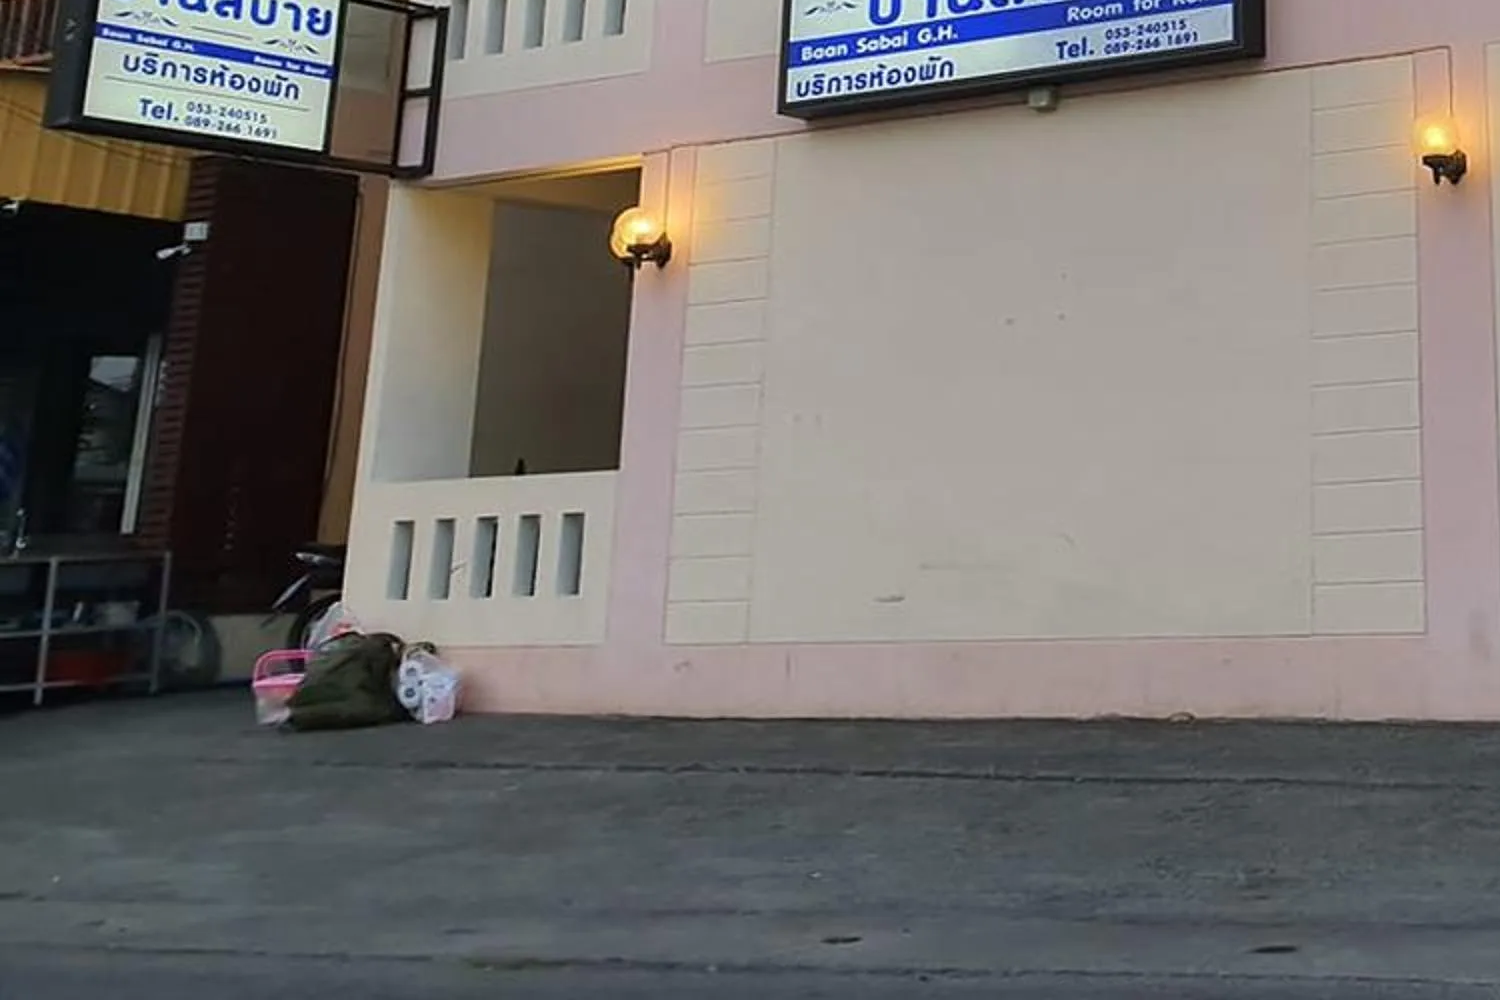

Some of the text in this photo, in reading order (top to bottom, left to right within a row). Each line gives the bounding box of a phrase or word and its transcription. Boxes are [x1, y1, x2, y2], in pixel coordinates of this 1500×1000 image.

[1067, 2, 1122, 22] Room
[801, 25, 958, 61] Baan Sabai G.H.
[1056, 19, 1187, 60] Tel. 053-240515
[1167, 31, 1198, 46] 1691
[123, 52, 299, 100] บริการห้องพัก
[796, 55, 954, 97] บริการห้องพัก
[140, 98, 267, 124] Tel. 053-240515
